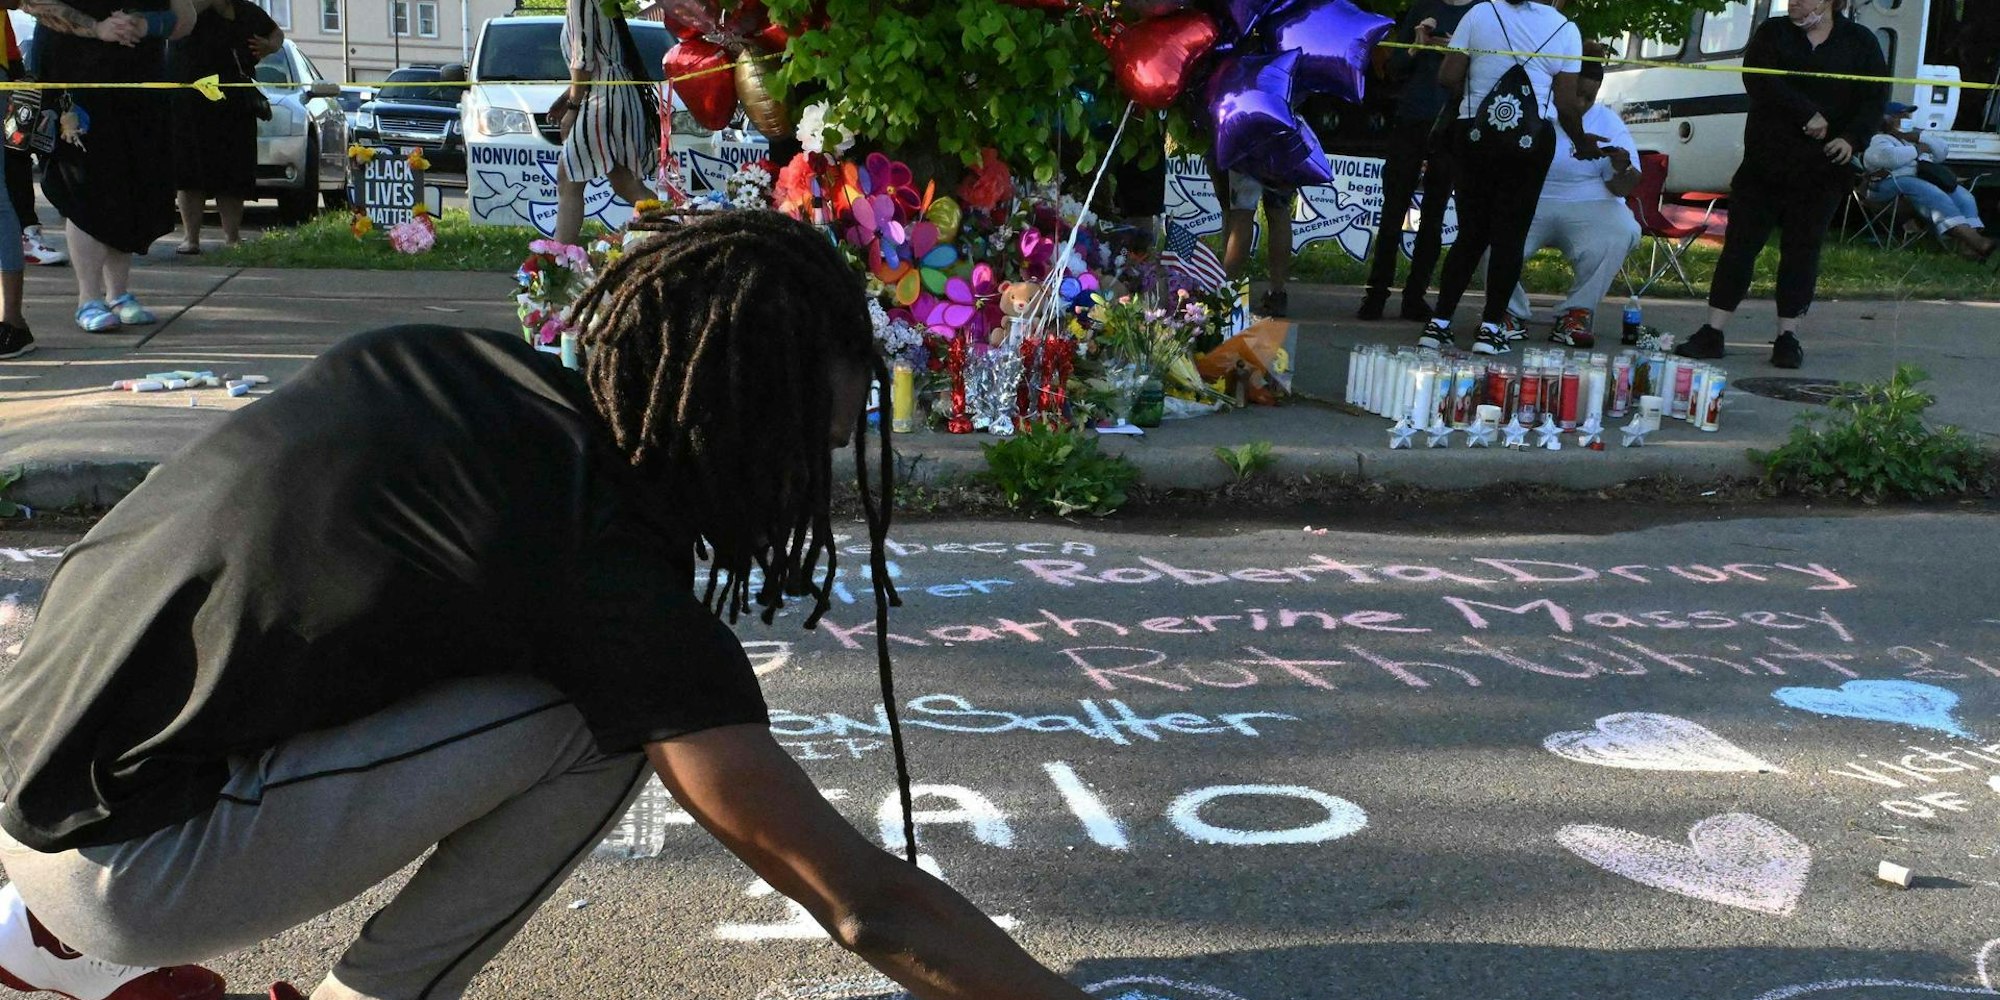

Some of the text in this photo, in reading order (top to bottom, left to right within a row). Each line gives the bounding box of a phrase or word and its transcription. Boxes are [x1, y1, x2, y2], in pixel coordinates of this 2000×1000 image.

[364, 159, 414, 181] BLACK
[364, 181, 415, 207] LIVES
[1309, 195, 1334, 204] Leave
[366, 207, 414, 225] MATTER
[1014, 553, 1502, 588] Roberta
[1471, 556, 1858, 591] Drury
[819, 596, 1854, 650] Katherine Massey
[1056, 645, 1483, 691] Ruth
[900, 693, 1302, 746] Salter
